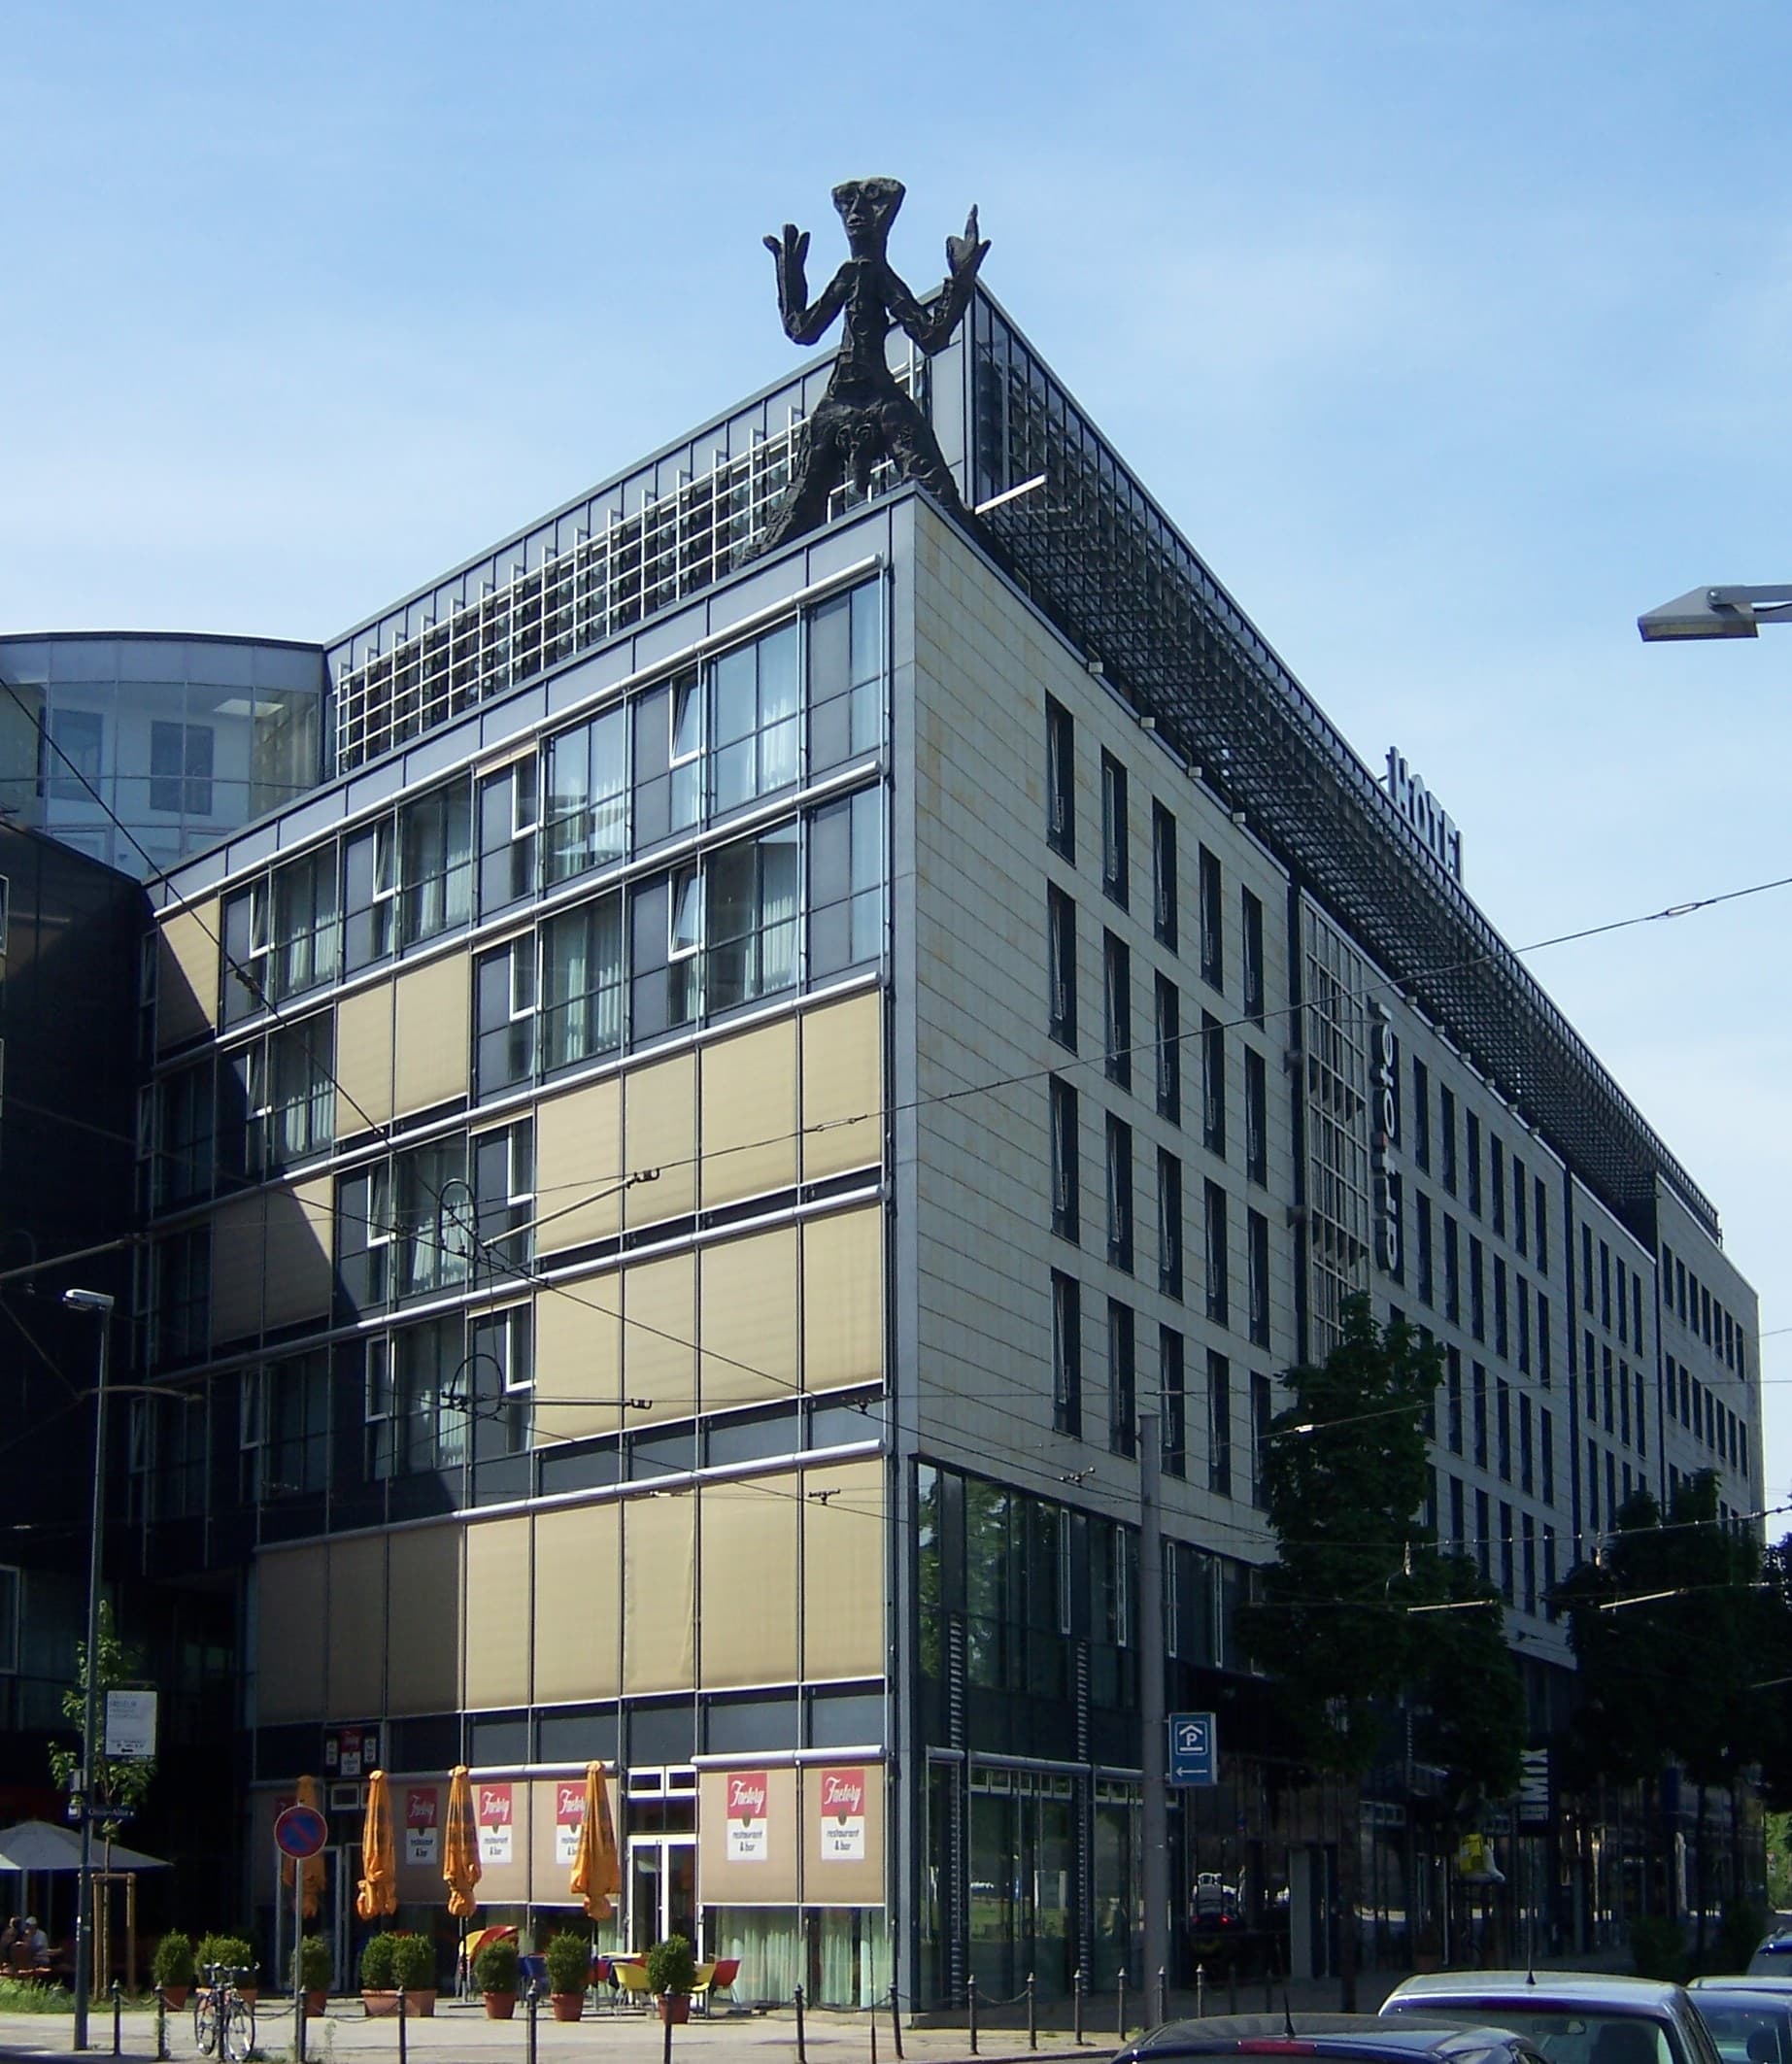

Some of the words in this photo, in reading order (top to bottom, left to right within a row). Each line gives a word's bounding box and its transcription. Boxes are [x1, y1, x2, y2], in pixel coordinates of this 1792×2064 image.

[1389, 746, 1465, 886] HOTEL
[729, 1779, 765, 1814] Factory
[824, 1776, 862, 1812] Factory
[481, 1791, 510, 1822] Factory
[732, 1829, 762, 1839] restaurant
[827, 1828, 860, 1838] restaurant
[745, 1842, 756, 1852] bar
[840, 1841, 852, 1851] bar
